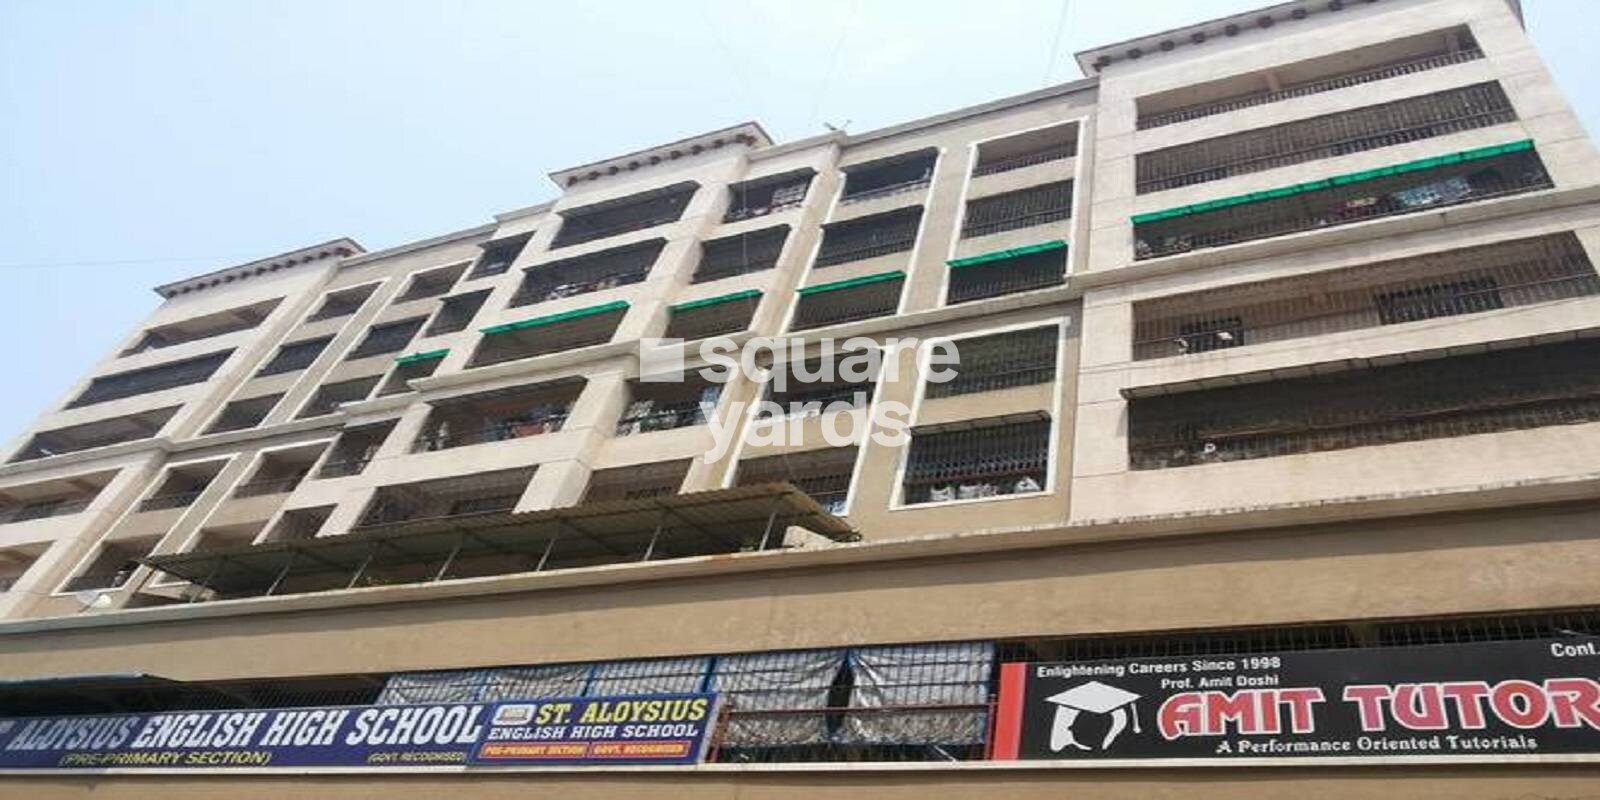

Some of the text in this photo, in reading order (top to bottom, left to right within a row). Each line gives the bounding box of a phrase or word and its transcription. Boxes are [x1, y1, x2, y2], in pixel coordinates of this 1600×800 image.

[1037, 656, 1281, 678] Enlightening Careers Since 1998
[1161, 674, 1279, 689] Prof. Amit Doshi
[535, 703, 573, 725] ST.
[579, 698, 708, 723] ALOYSIUS
[1157, 687, 1326, 740] AMIT
[5, 717, 140, 751] ALOYSIUS
[130, 712, 266, 749] ENGLISH
[259, 709, 350, 747] HIGH
[346, 705, 483, 745] SCHOOL
[487, 723, 699, 740] ENGLISH HIGH SCHOOL
[1216, 734, 1538, 754] A Performance Oriented Tutorials
